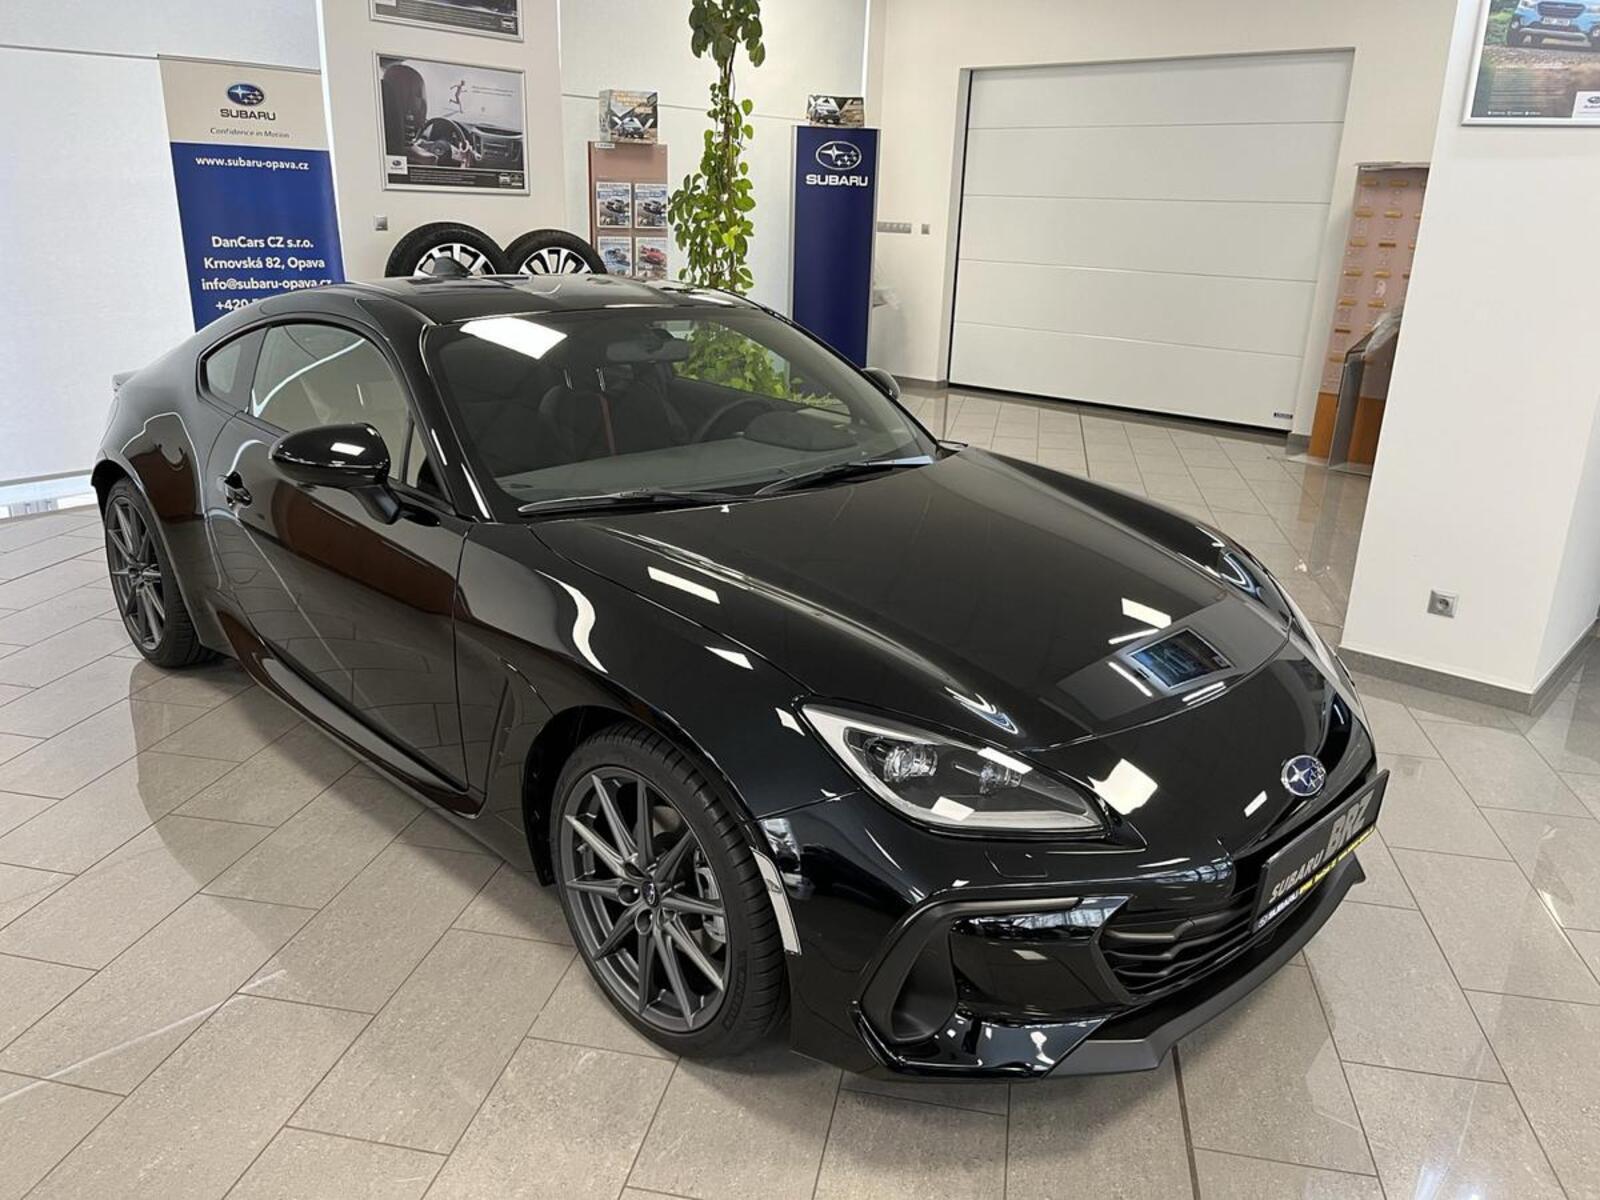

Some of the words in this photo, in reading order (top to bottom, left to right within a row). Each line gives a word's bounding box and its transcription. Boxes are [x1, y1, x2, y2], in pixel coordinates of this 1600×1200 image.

[220, 108, 277, 121] SUBARU
[210, 127, 254, 137] Confidence
[256, 130, 263, 138] in
[264, 130, 290, 139] Motion
[196, 156, 309, 171] www.subaru-opava.cz
[806, 174, 868, 187] SUBARU
[211, 235, 265, 249] DanCars
[267, 236, 284, 249] CZ
[287, 237, 314, 249] s.r.o.
[265, 257, 285, 271] 82,
[287, 257, 325, 272] Opava
[201, 278, 332, 291] info@subaru-opavac
[1268, 848, 1325, 904] SUBARU
[1323, 788, 1376, 862] BRZ
